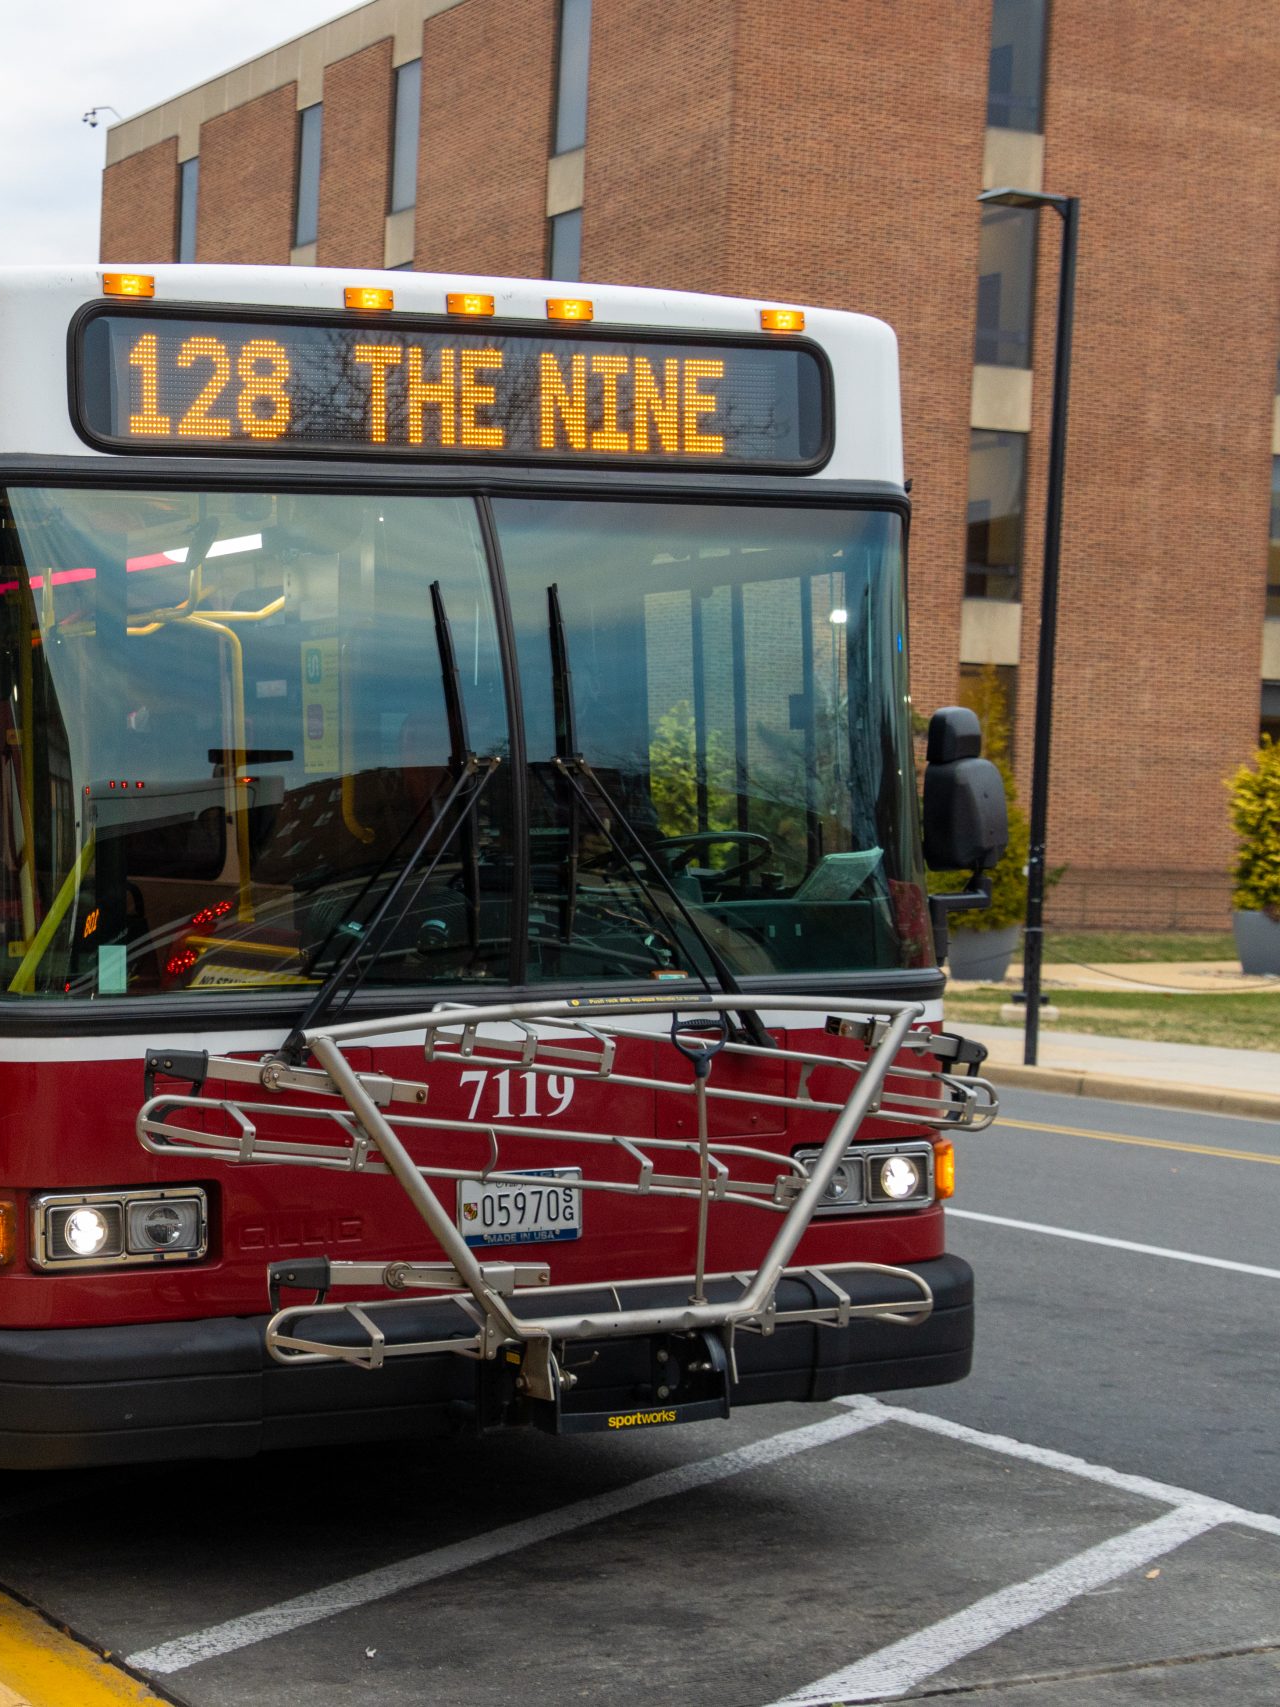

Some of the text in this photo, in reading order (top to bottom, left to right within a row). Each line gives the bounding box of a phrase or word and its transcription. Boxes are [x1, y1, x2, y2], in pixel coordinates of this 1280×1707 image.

[127, 332, 724, 454] 128 THE NINE
[459, 1069, 575, 1120] 7119
[482, 1189, 559, 1227] 05970
[487, 1230, 555, 1244] MADE IN USA
[608, 1410, 677, 1429] sportworks
